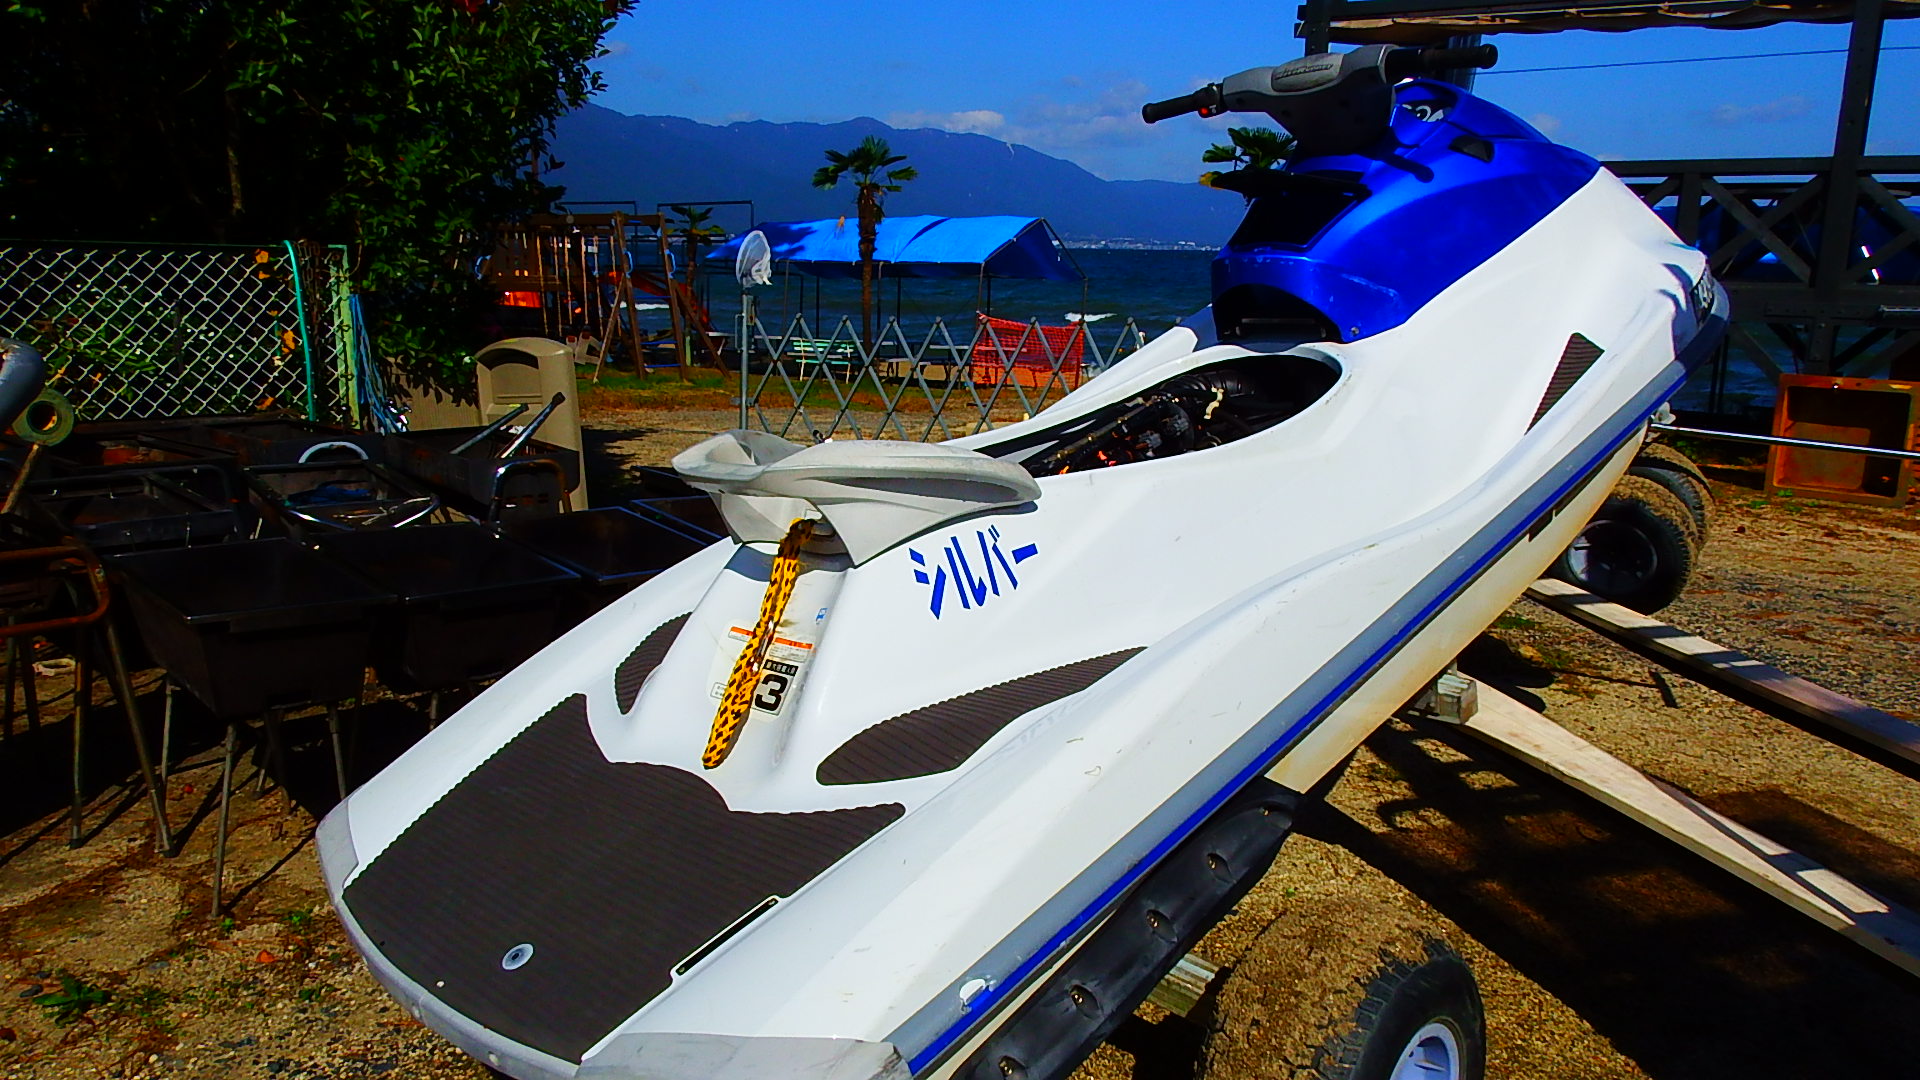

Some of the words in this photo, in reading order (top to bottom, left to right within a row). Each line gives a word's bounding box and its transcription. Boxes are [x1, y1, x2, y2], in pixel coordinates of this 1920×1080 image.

[908, 524, 1038, 620] シルバー
[754, 673, 788, 712] 3
